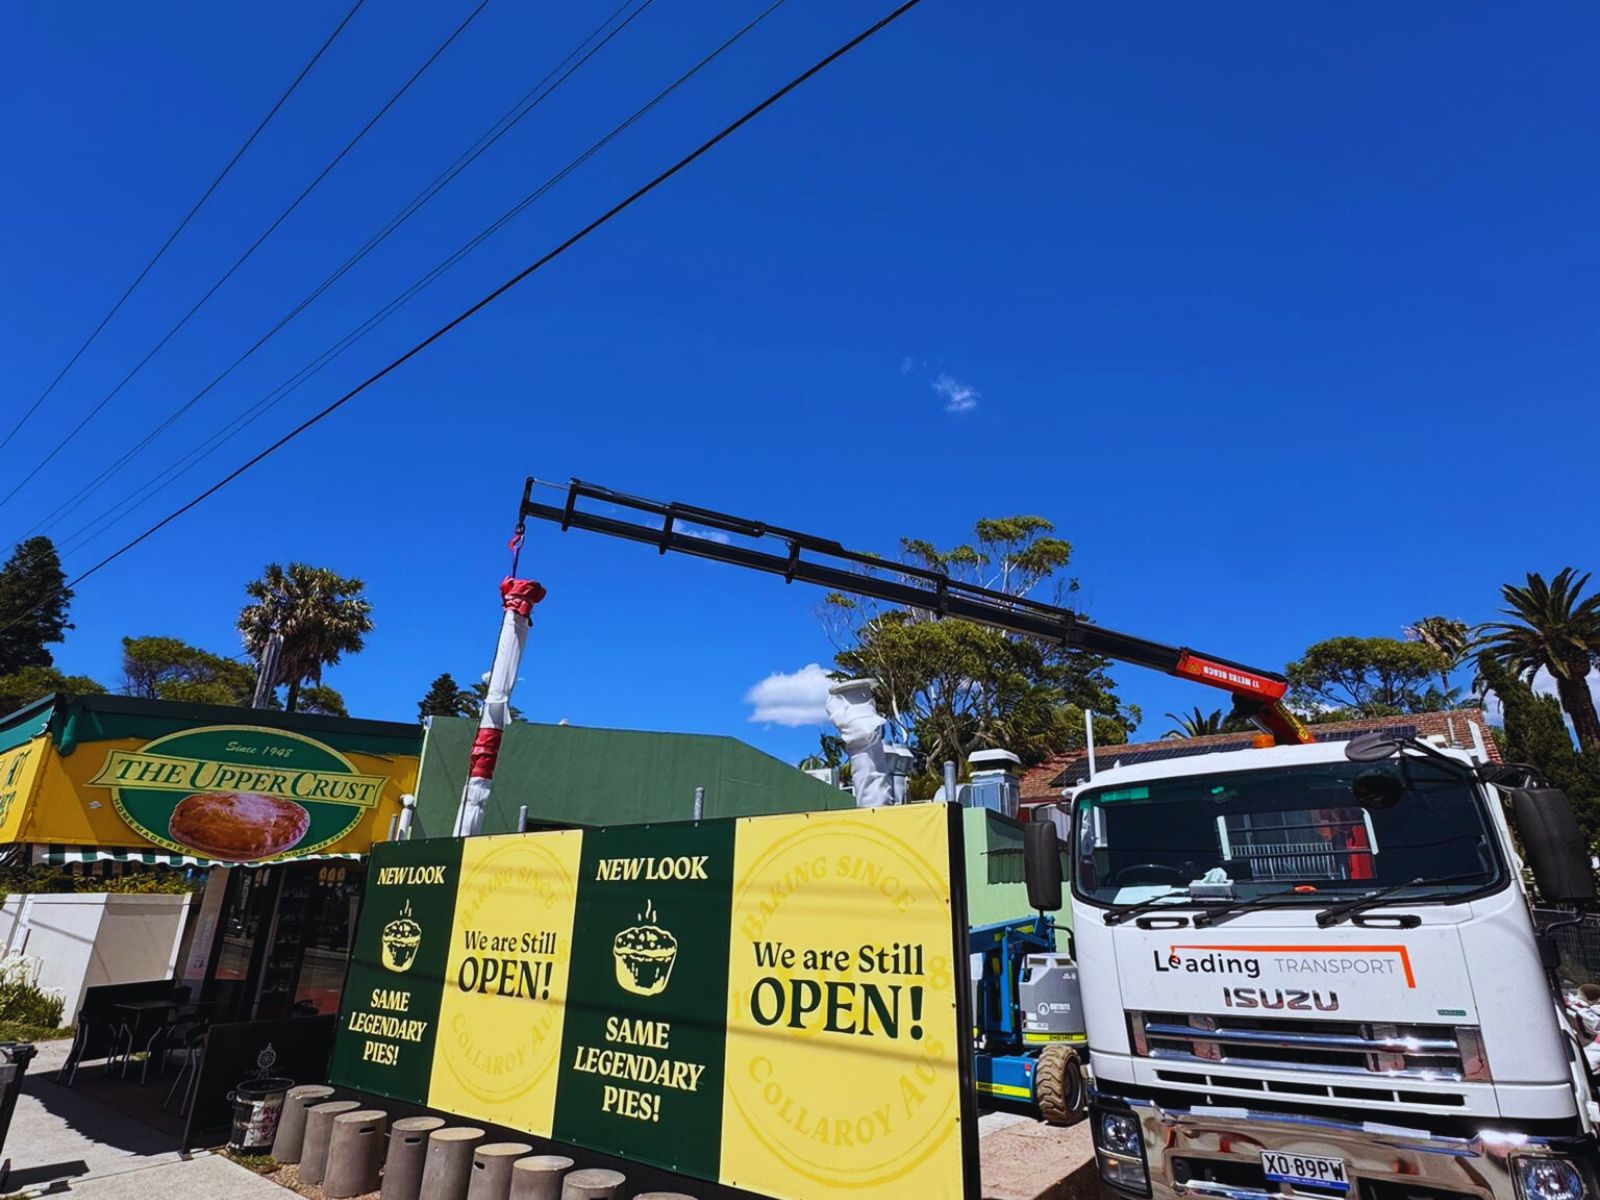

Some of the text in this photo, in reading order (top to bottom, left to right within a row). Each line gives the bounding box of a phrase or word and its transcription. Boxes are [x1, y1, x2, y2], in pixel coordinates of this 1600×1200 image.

[225, 741, 293, 758] Since 1948
[115, 759, 378, 801] THE UPPER CRUST
[377, 866, 446, 885] NEW LOOK
[595, 856, 709, 881] NEW LOOK
[740, 855, 918, 942] BAKING SINCE
[465, 930, 488, 950] We
[491, 936, 517, 952] are
[520, 931, 556, 954] Still
[752, 941, 924, 975] We are Still
[458, 956, 553, 1001] OPEN!
[1153, 950, 1397, 978] Leading TRANSPORT
[371, 988, 411, 1013] SAME
[750, 976, 924, 1040] OPEN!
[1223, 986, 1340, 1011] ISUZU
[348, 1011, 428, 1043] LEGENDARY
[605, 1016, 670, 1049] SAME
[363, 1041, 399, 1066] PIES!
[573, 1046, 705, 1091] LEGENDARY
[602, 1085, 661, 1122] PIES!
[748, 1055, 895, 1146] COLLAROY
